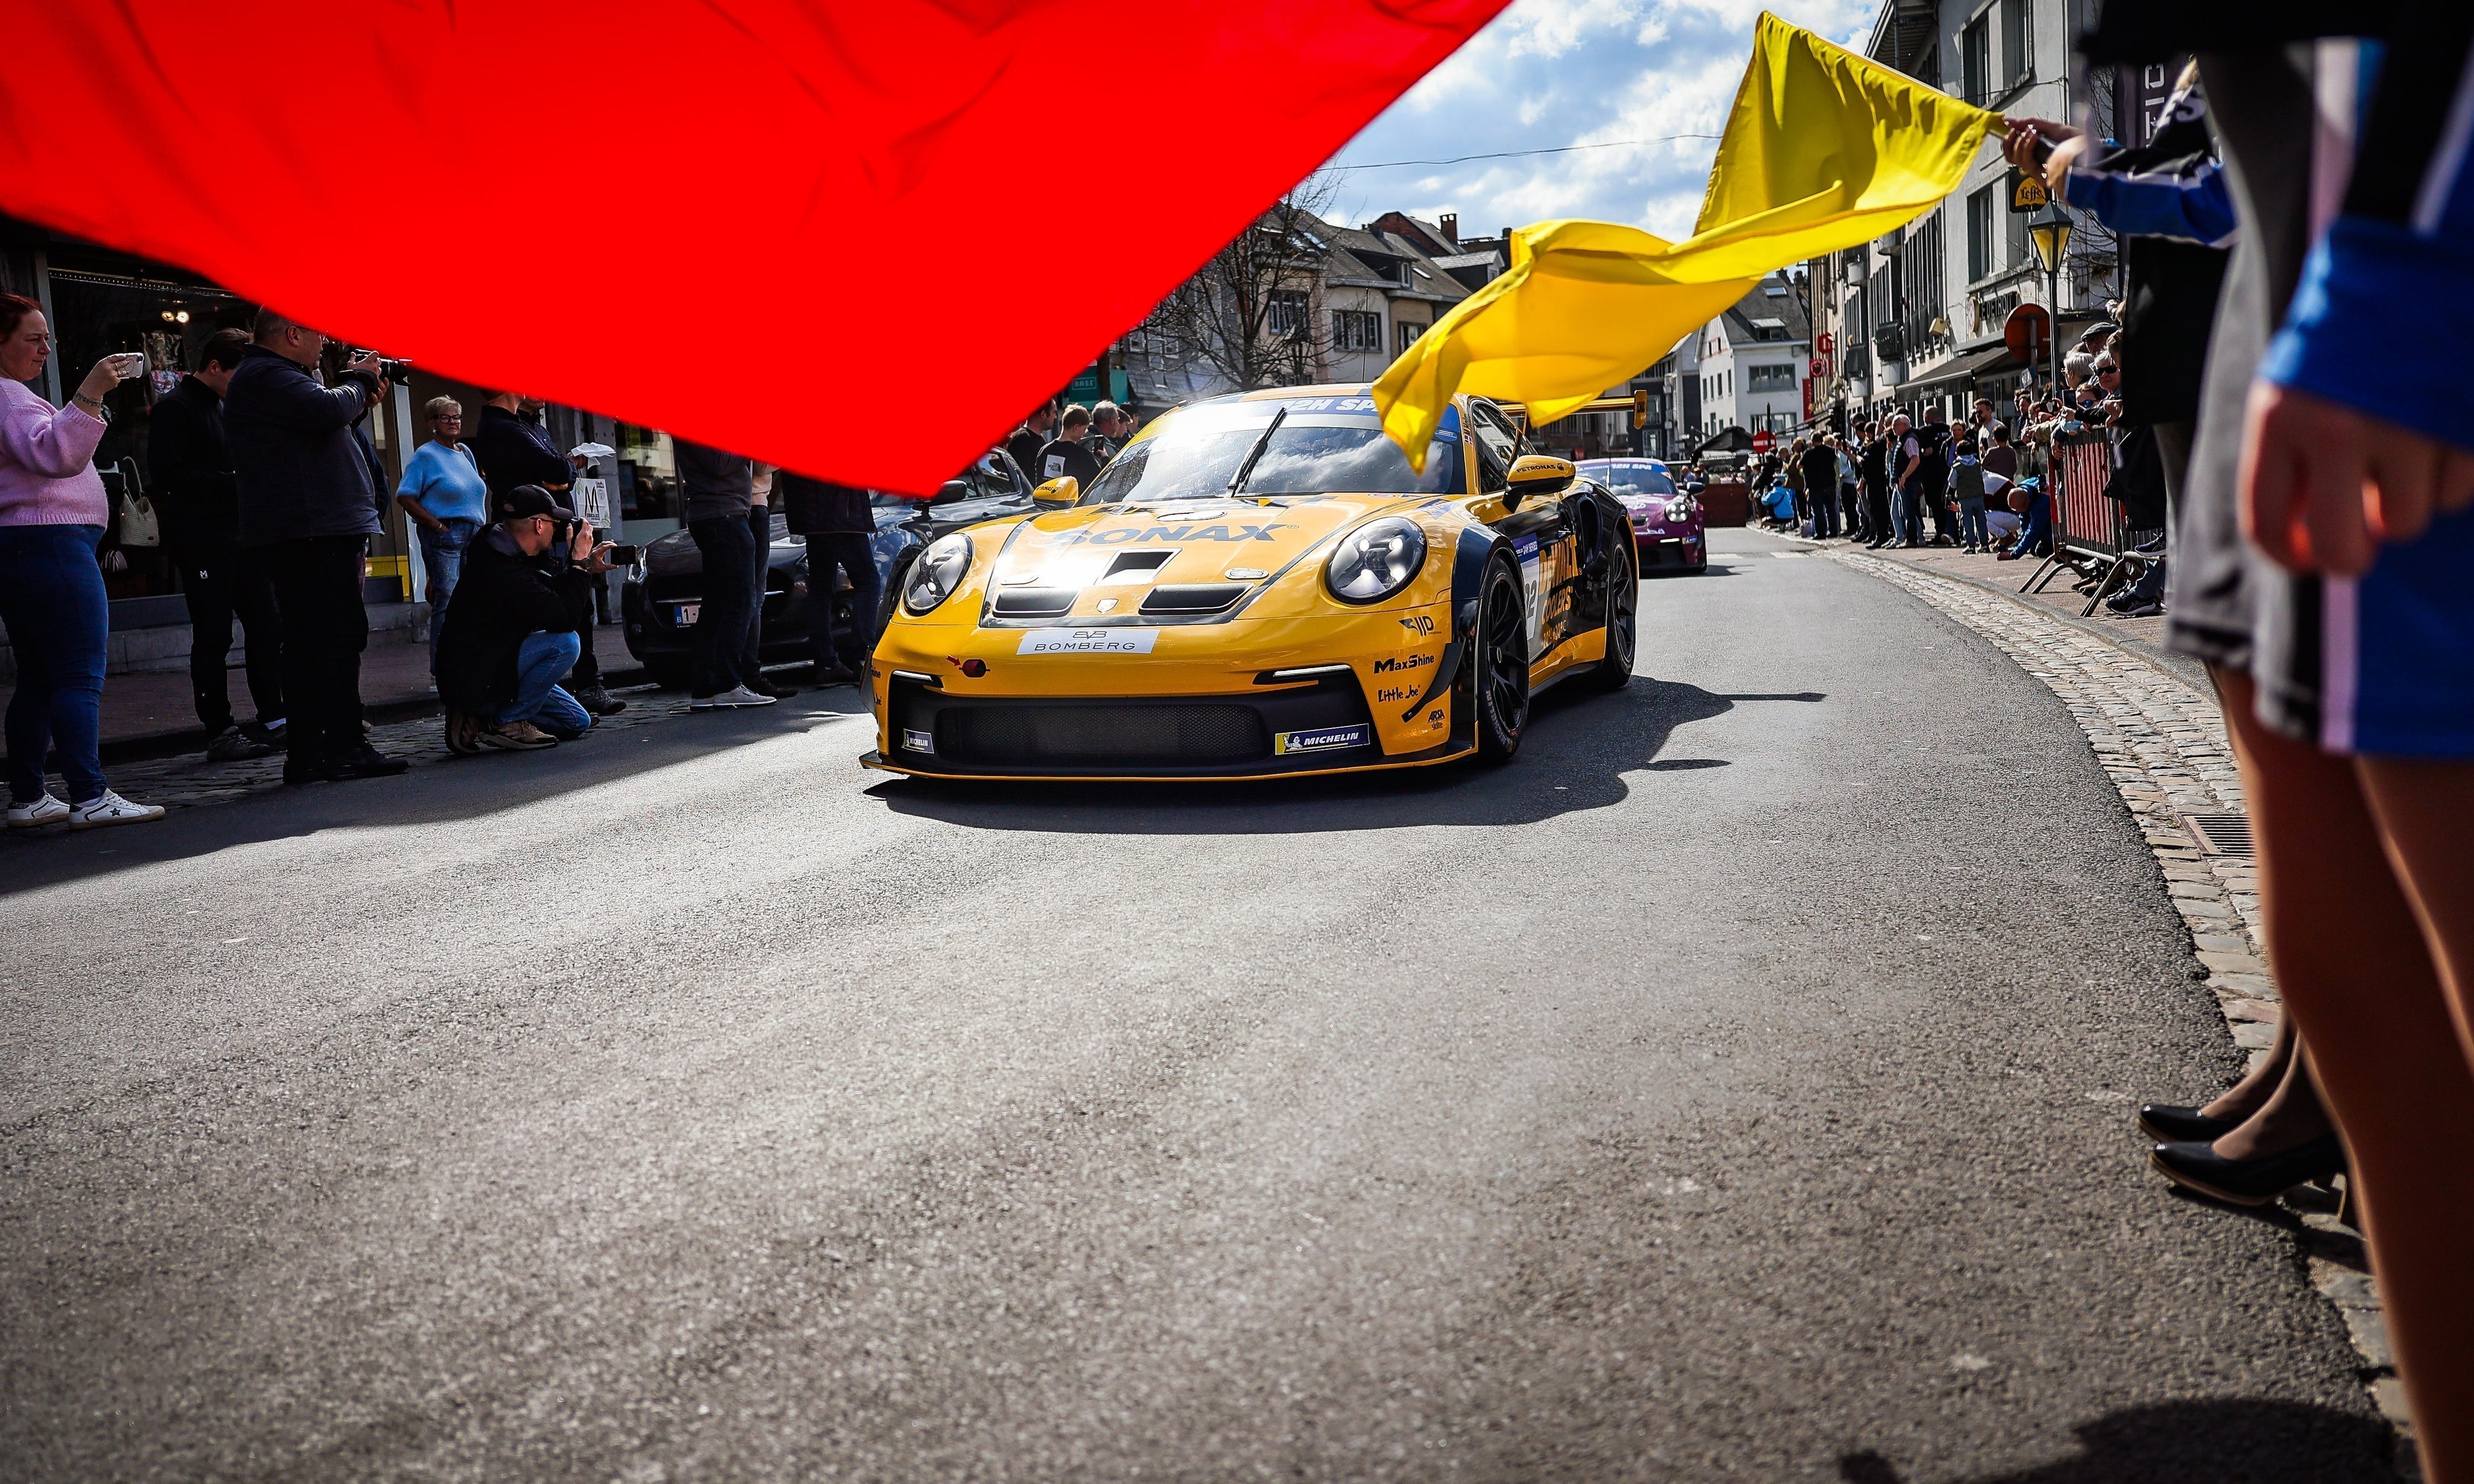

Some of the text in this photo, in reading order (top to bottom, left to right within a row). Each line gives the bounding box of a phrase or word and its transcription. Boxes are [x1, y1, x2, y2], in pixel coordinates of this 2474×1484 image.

[2019, 186, 2041, 201] Leffe
[1987, 293, 2012, 319] DETROIT
[1278, 399, 1335, 411] 12H
[1516, 464, 1556, 473] PETRONAS
[1054, 524, 1288, 544] SONAX
[1542, 586, 1571, 625] COOLERS
[1034, 642, 1136, 651] BOMBERG
[1373, 653, 1434, 674] MaxShine
[1378, 684, 1419, 703] Little Joe
[909, 737, 928, 747] MICHELIN
[1303, 732, 1359, 746] MICHELIN
